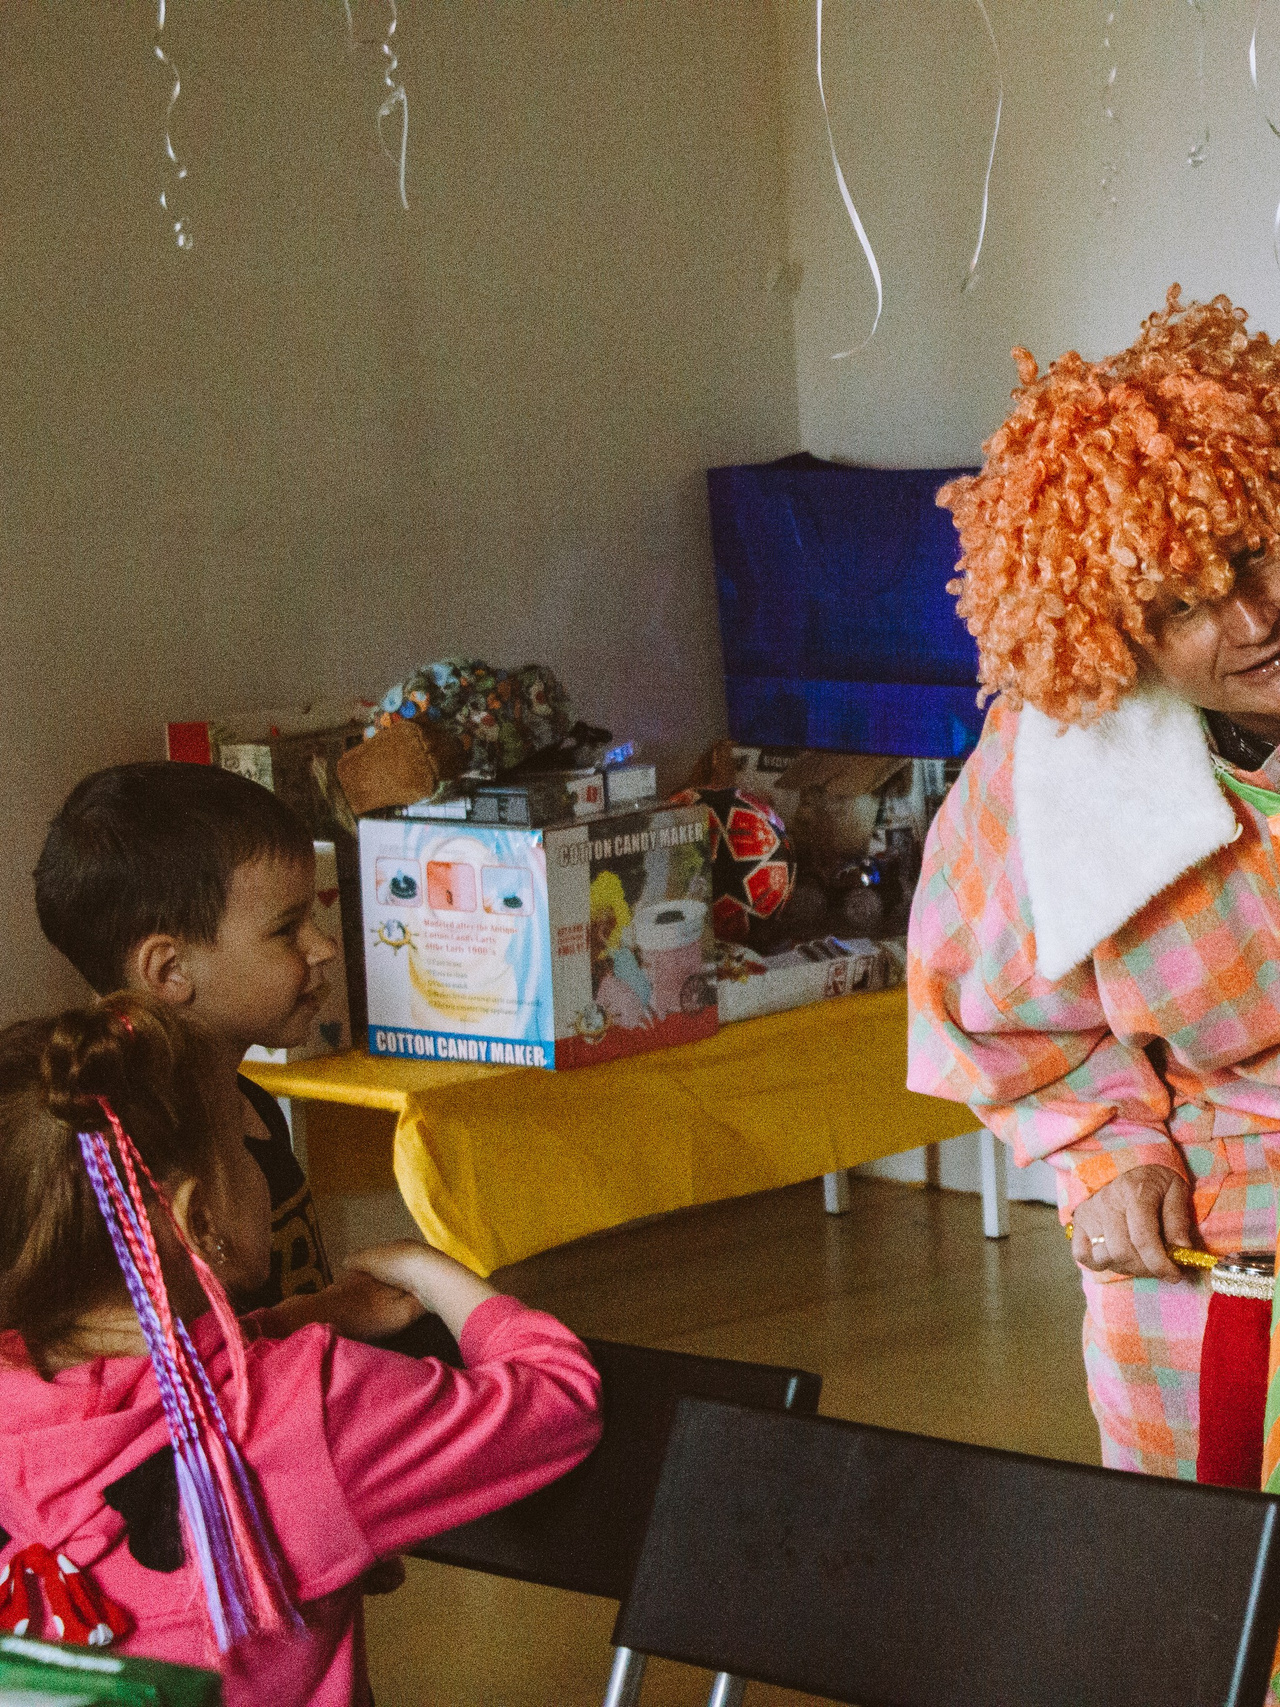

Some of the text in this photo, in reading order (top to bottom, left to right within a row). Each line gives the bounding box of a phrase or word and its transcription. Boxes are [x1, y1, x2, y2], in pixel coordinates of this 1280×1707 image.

[559, 823, 704, 868] COTTON CANDY MAKER
[376, 1030, 546, 1067] COTTON CANDY MAKER
